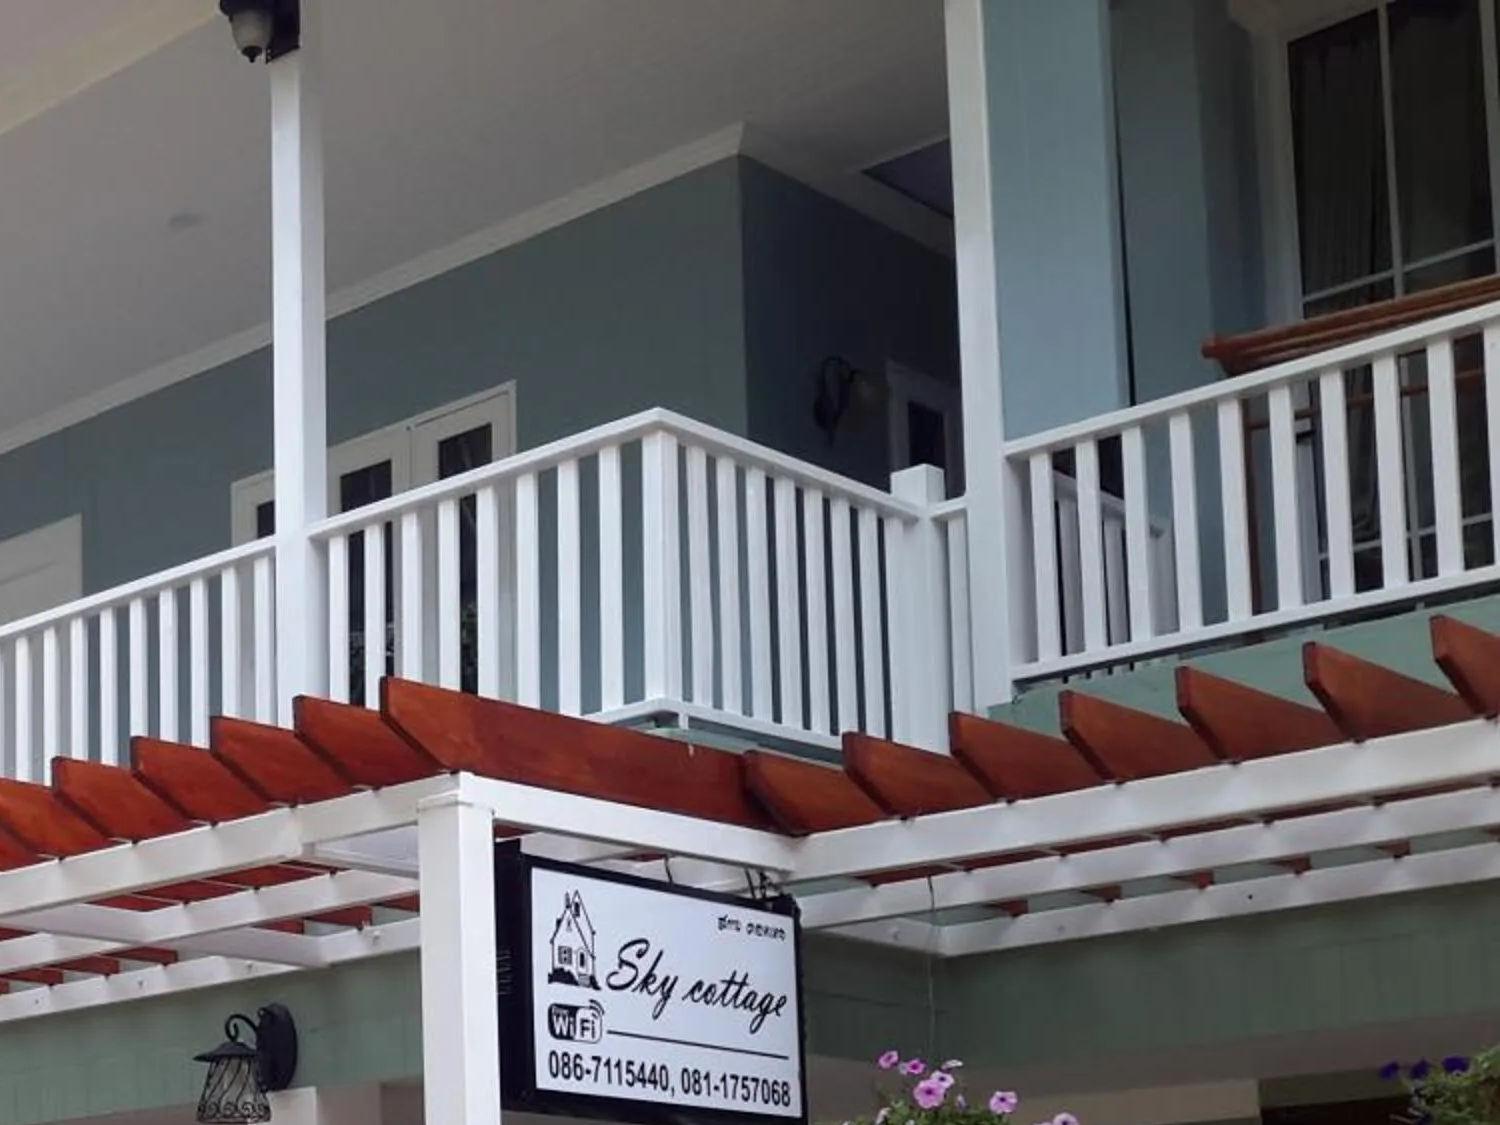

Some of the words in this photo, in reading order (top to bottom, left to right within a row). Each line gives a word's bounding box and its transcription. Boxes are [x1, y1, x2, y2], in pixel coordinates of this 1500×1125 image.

[606, 938, 678, 1020] Sky
[682, 970, 787, 1034] cottage
[681, 1067, 791, 1107] 081-1757068
